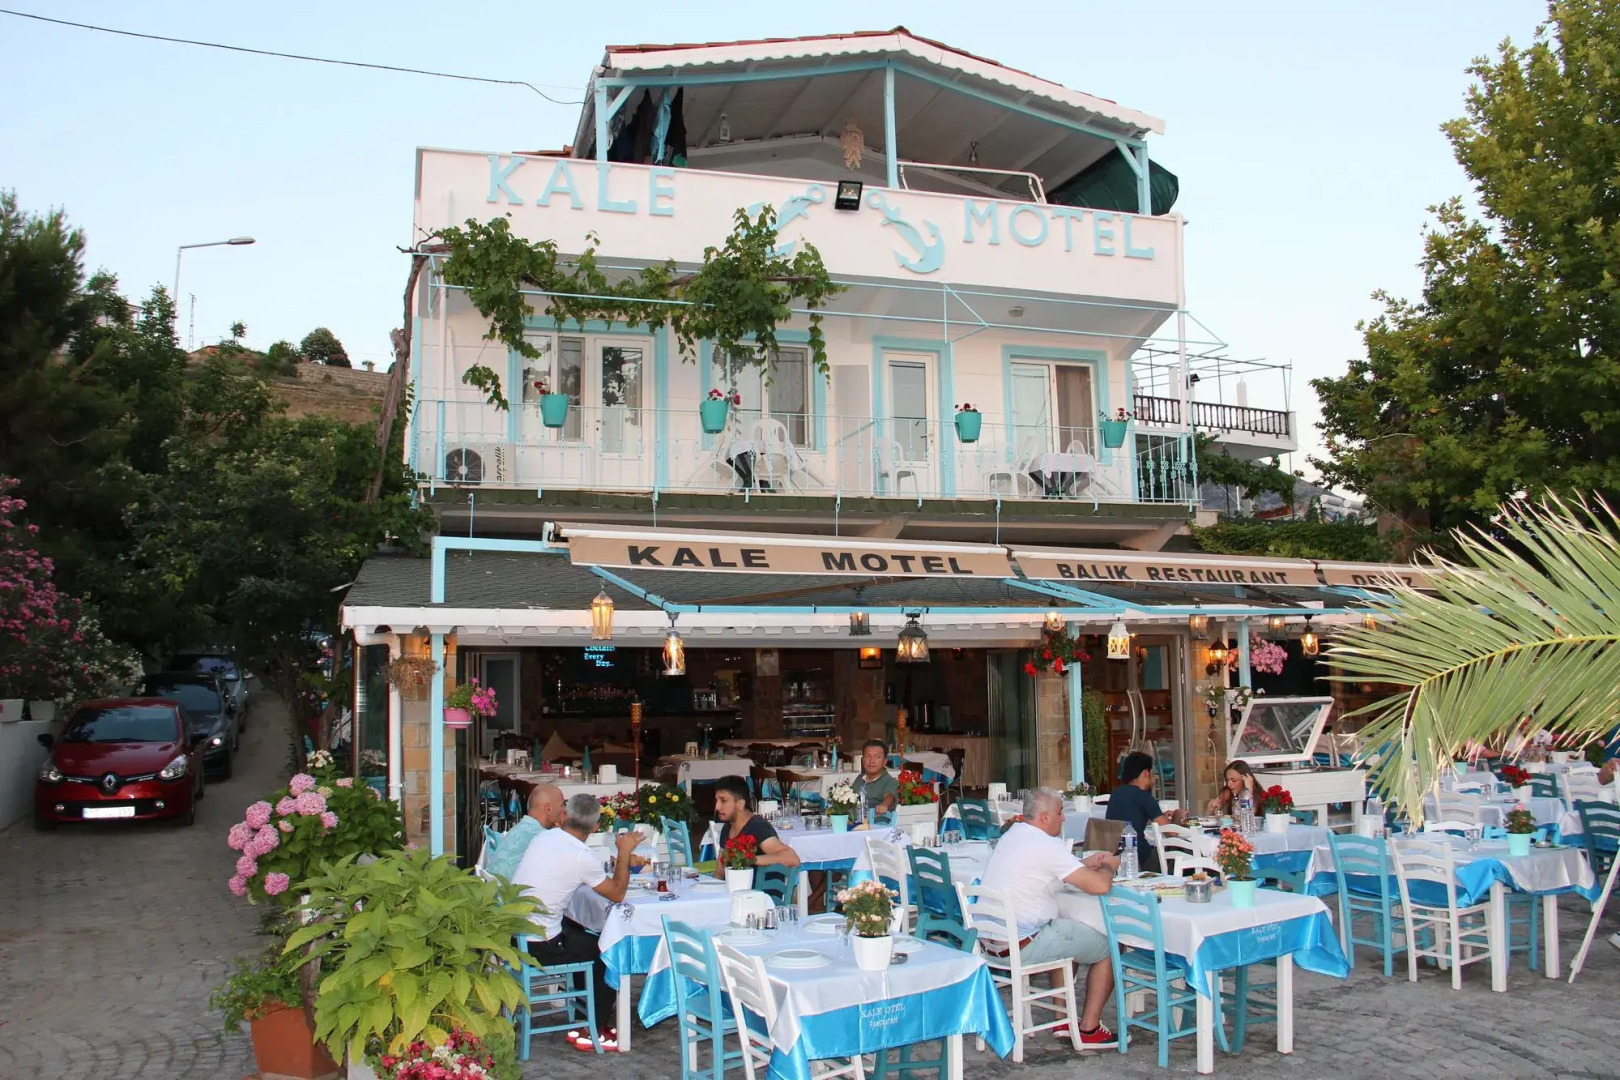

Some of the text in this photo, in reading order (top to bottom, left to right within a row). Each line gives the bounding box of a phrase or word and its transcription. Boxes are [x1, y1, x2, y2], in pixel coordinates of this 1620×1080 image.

[486, 154, 1155, 260] KALE MOTEL
[627, 545, 973, 574] KALE MOTEL
[1056, 563, 1288, 584] BALIK RESTAURANT
[861, 1003, 905, 1018] KALE OTEL
